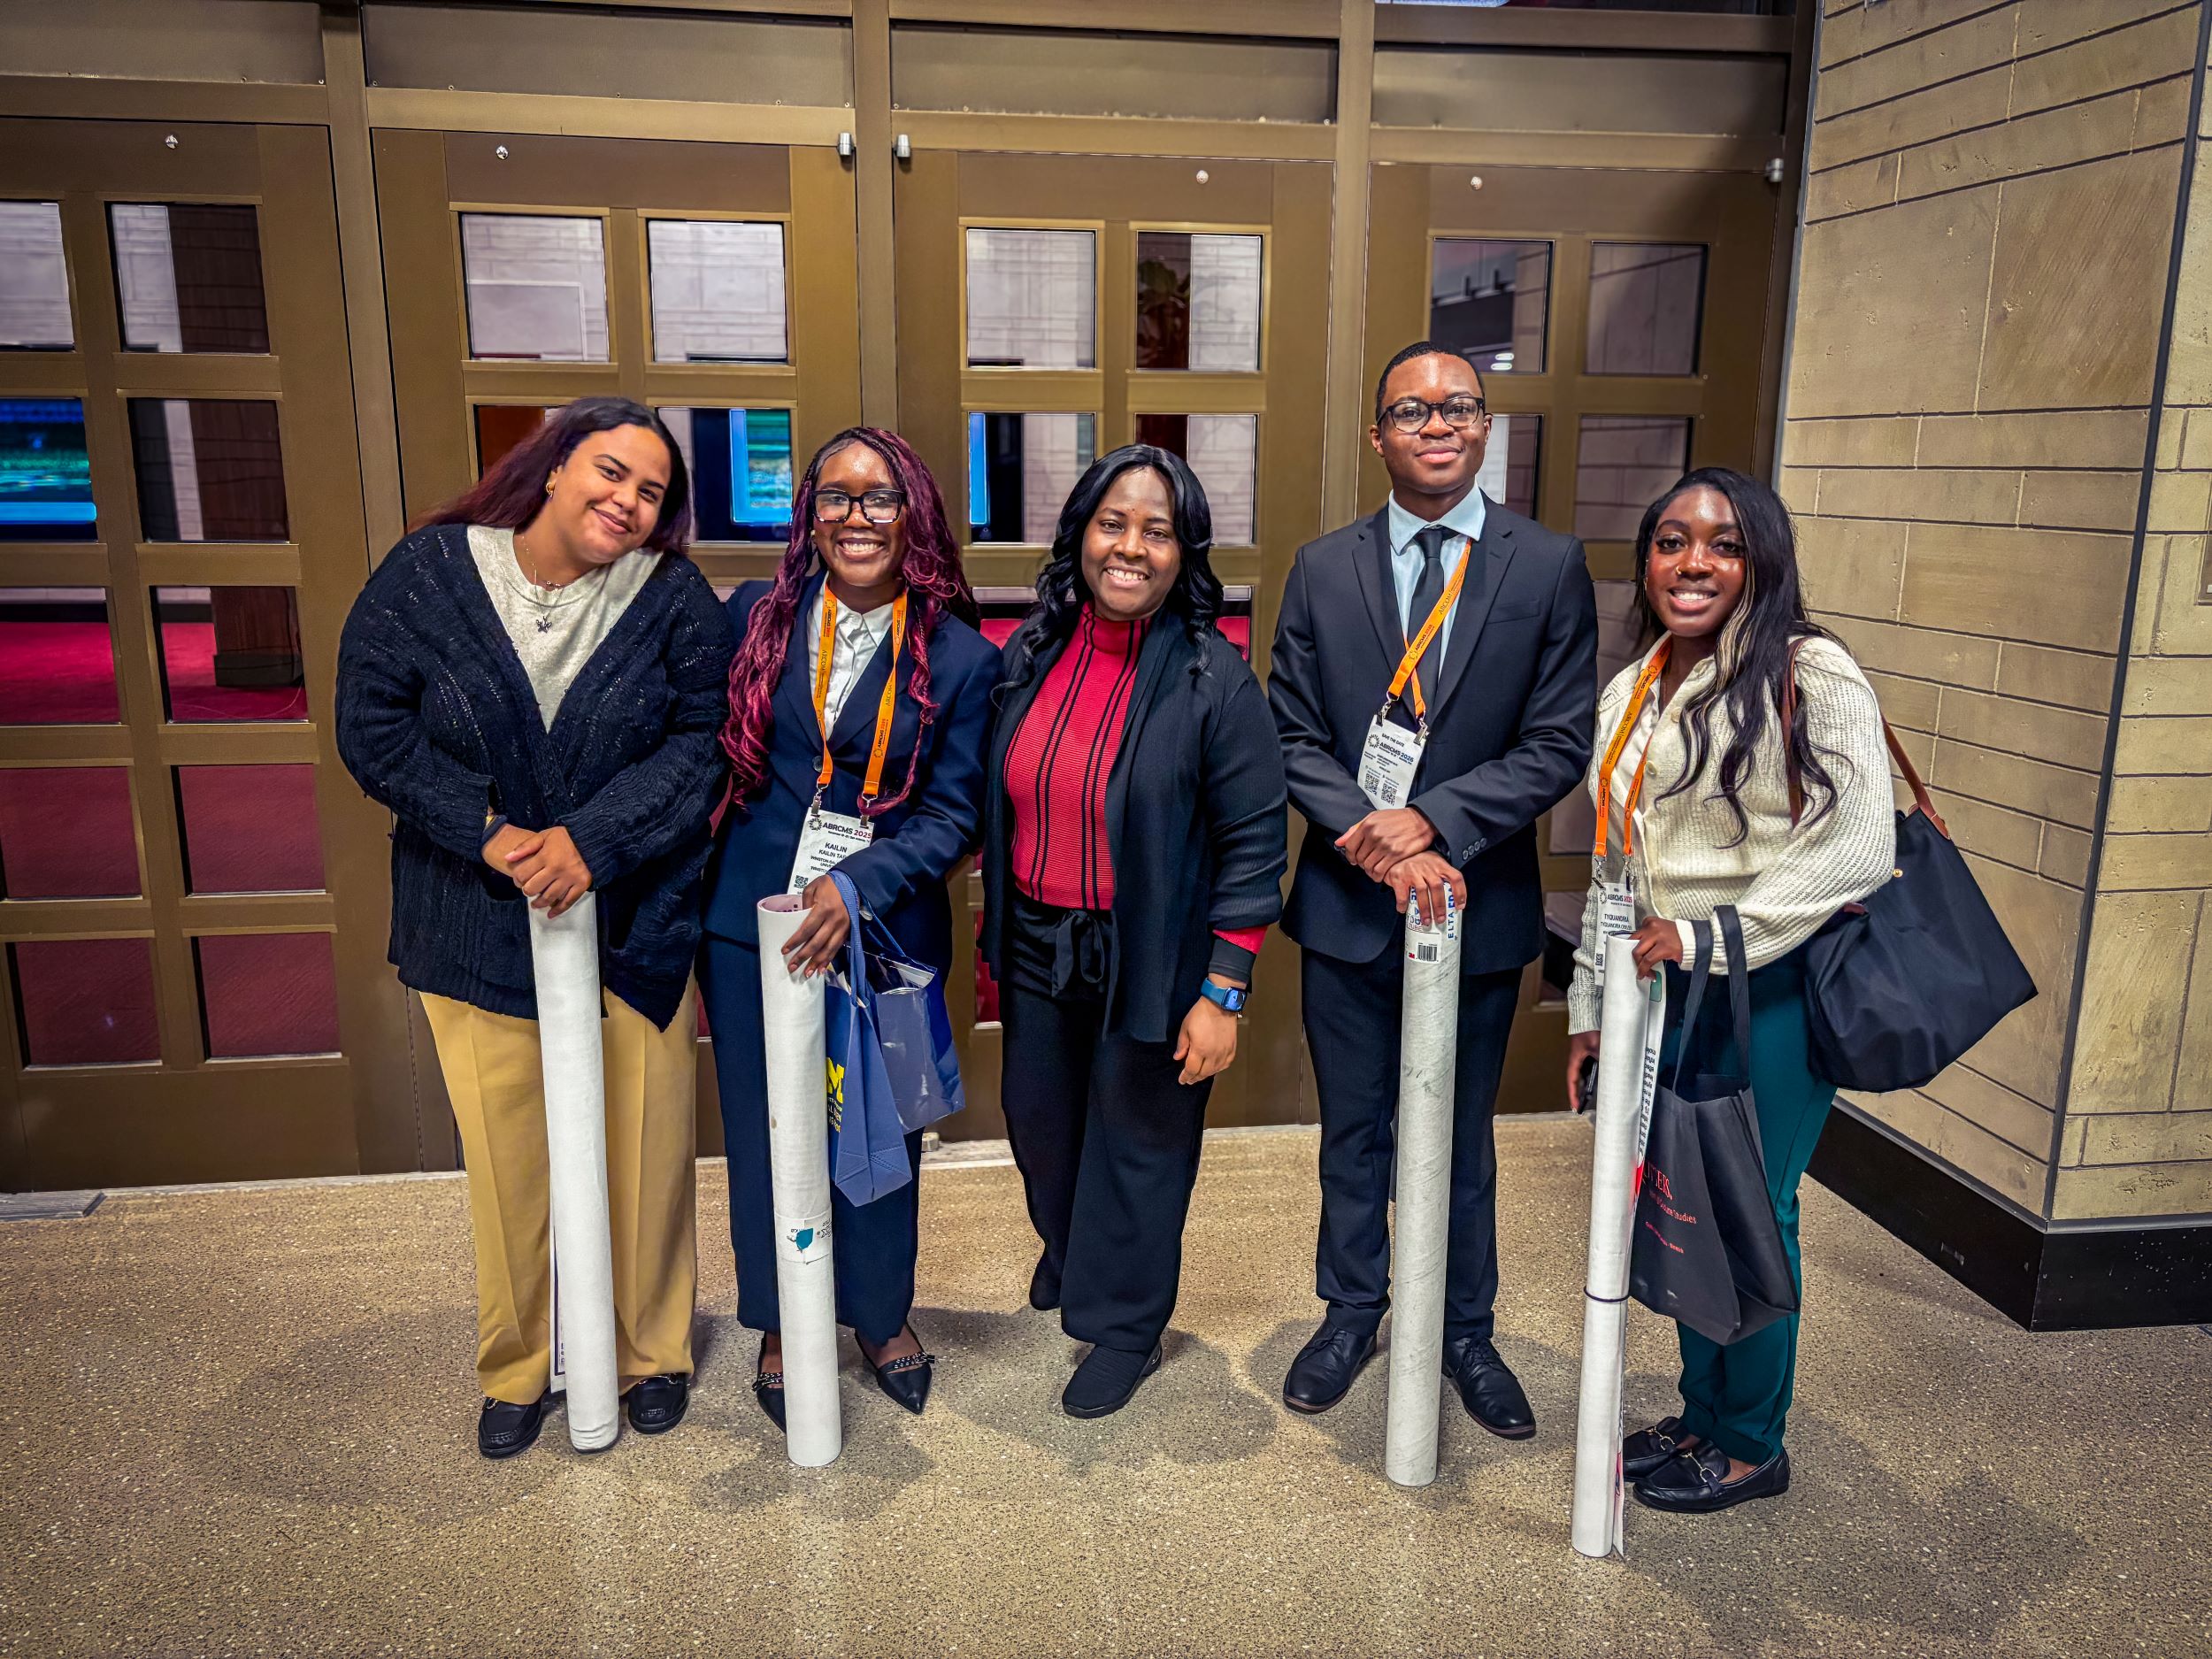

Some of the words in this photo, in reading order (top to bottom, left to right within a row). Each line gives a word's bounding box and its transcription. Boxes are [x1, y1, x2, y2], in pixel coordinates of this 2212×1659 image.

[1379, 741, 1402, 756] ABRCMS
[1400, 752, 1414, 763] 2026
[823, 822, 853, 834] ABRCMS
[854, 829, 872, 839] 2025
[818, 849, 835, 858] KAILIN
[825, 842, 848, 853] KAILIN
[826, 1056, 845, 1103] M
